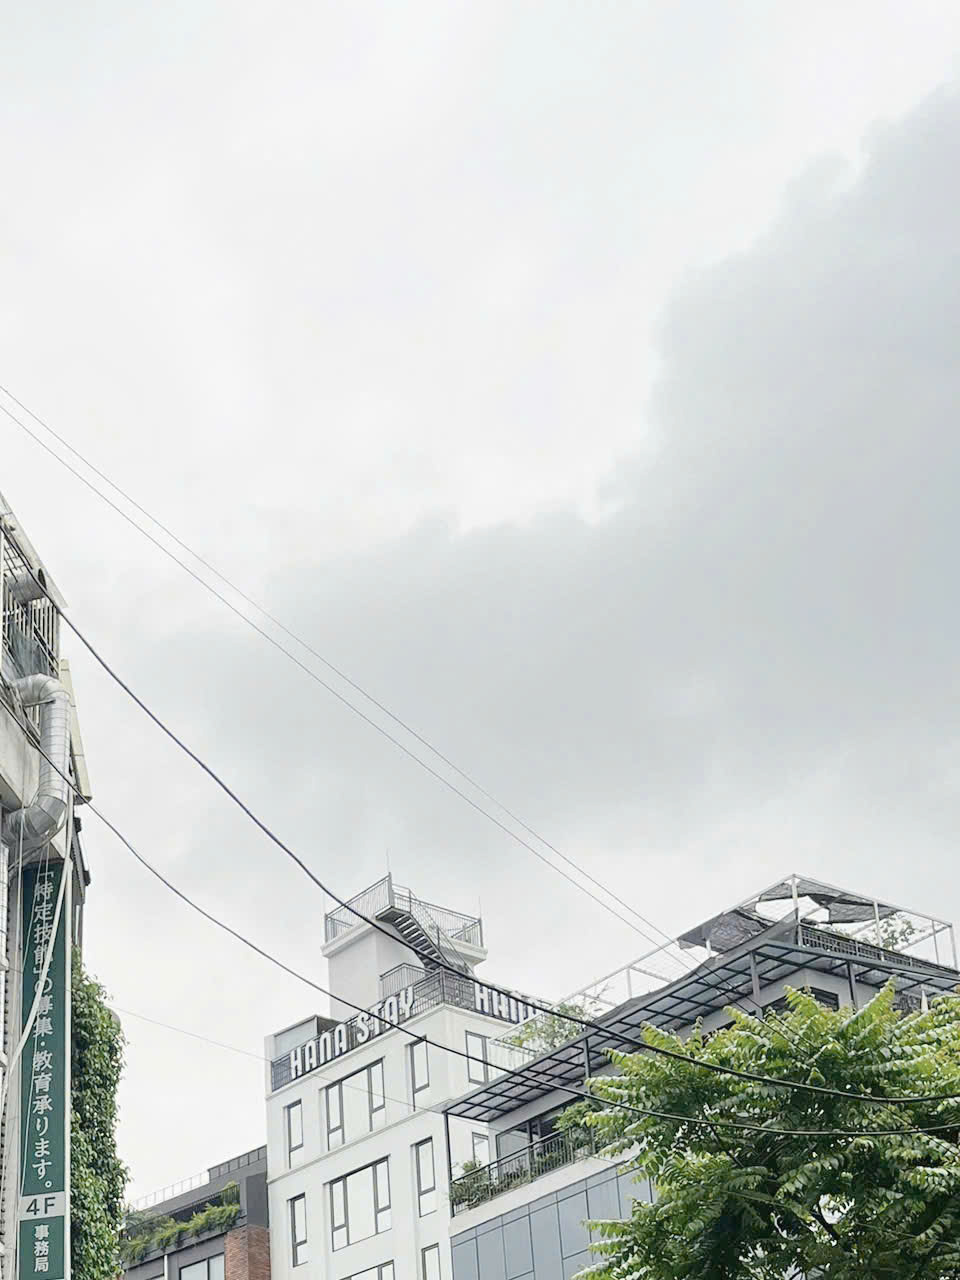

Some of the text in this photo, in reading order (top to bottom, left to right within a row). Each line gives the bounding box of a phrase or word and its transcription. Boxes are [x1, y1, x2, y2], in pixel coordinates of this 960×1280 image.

[290, 986, 415, 1079] HANA STAY
[26, 1197, 56, 1216] 4F
[34, 1224, 49, 1273] 事務局
